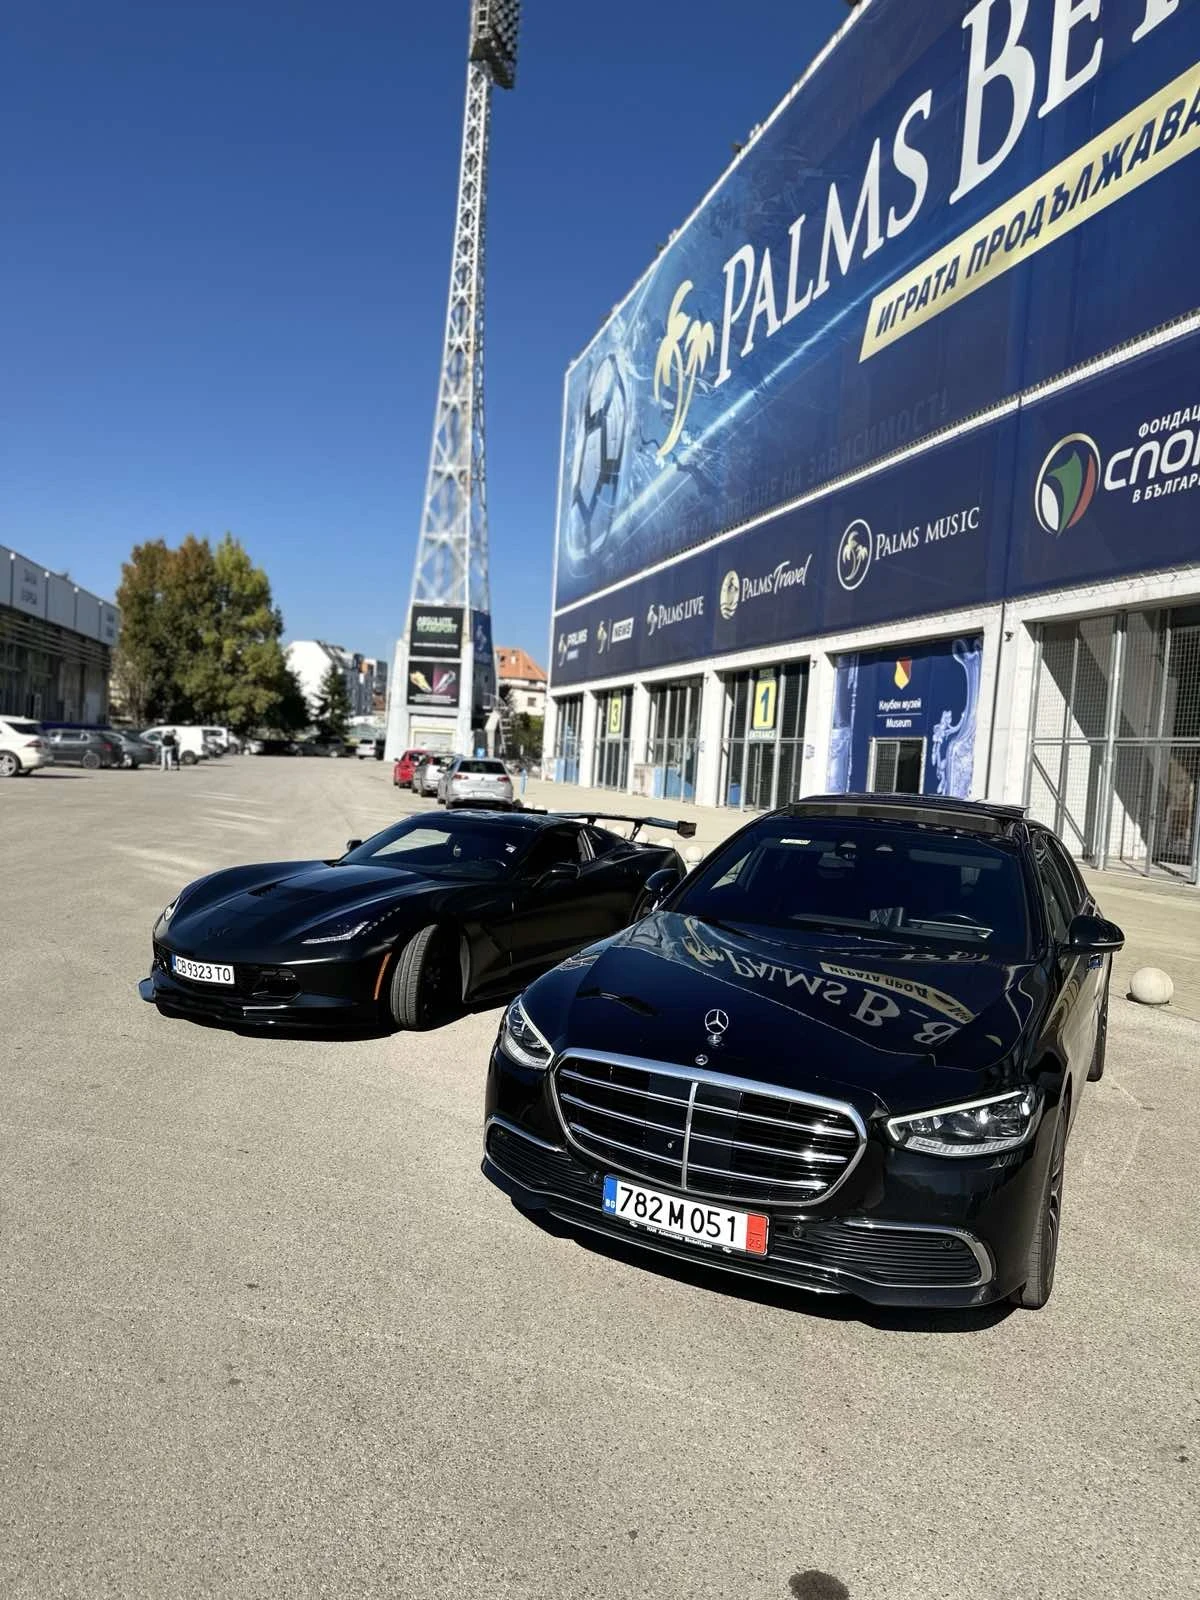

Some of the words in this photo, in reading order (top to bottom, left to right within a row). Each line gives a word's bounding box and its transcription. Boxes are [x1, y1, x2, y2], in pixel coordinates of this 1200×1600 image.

[875, 255, 961, 338] ИГРАТА
[965, 86, 1200, 279] ПРОДЪЛЖАВА
[714, 89, 933, 388] PALMS
[1103, 429, 1200, 491] СПО
[1132, 489, 1141, 503] В
[1144, 473, 1200, 500] БЪЛГАР
[875, 527, 920, 561] PALMS
[925, 506, 980, 543] MUSIC
[741, 574, 772, 602] PALMS
[772, 553, 813, 594] Travel
[657, 605, 684, 629] PALMS
[684, 596, 705, 619] LIVE
[614, 621, 633, 640] NEWS
[612, 703, 619, 727] 3
[760, 686, 770, 722] 1
[878, 698, 902, 712] Клубен
[901, 697, 922, 711] музей
[885, 718, 912, 729] Museum
[605, 1198, 616, 1210] BG
